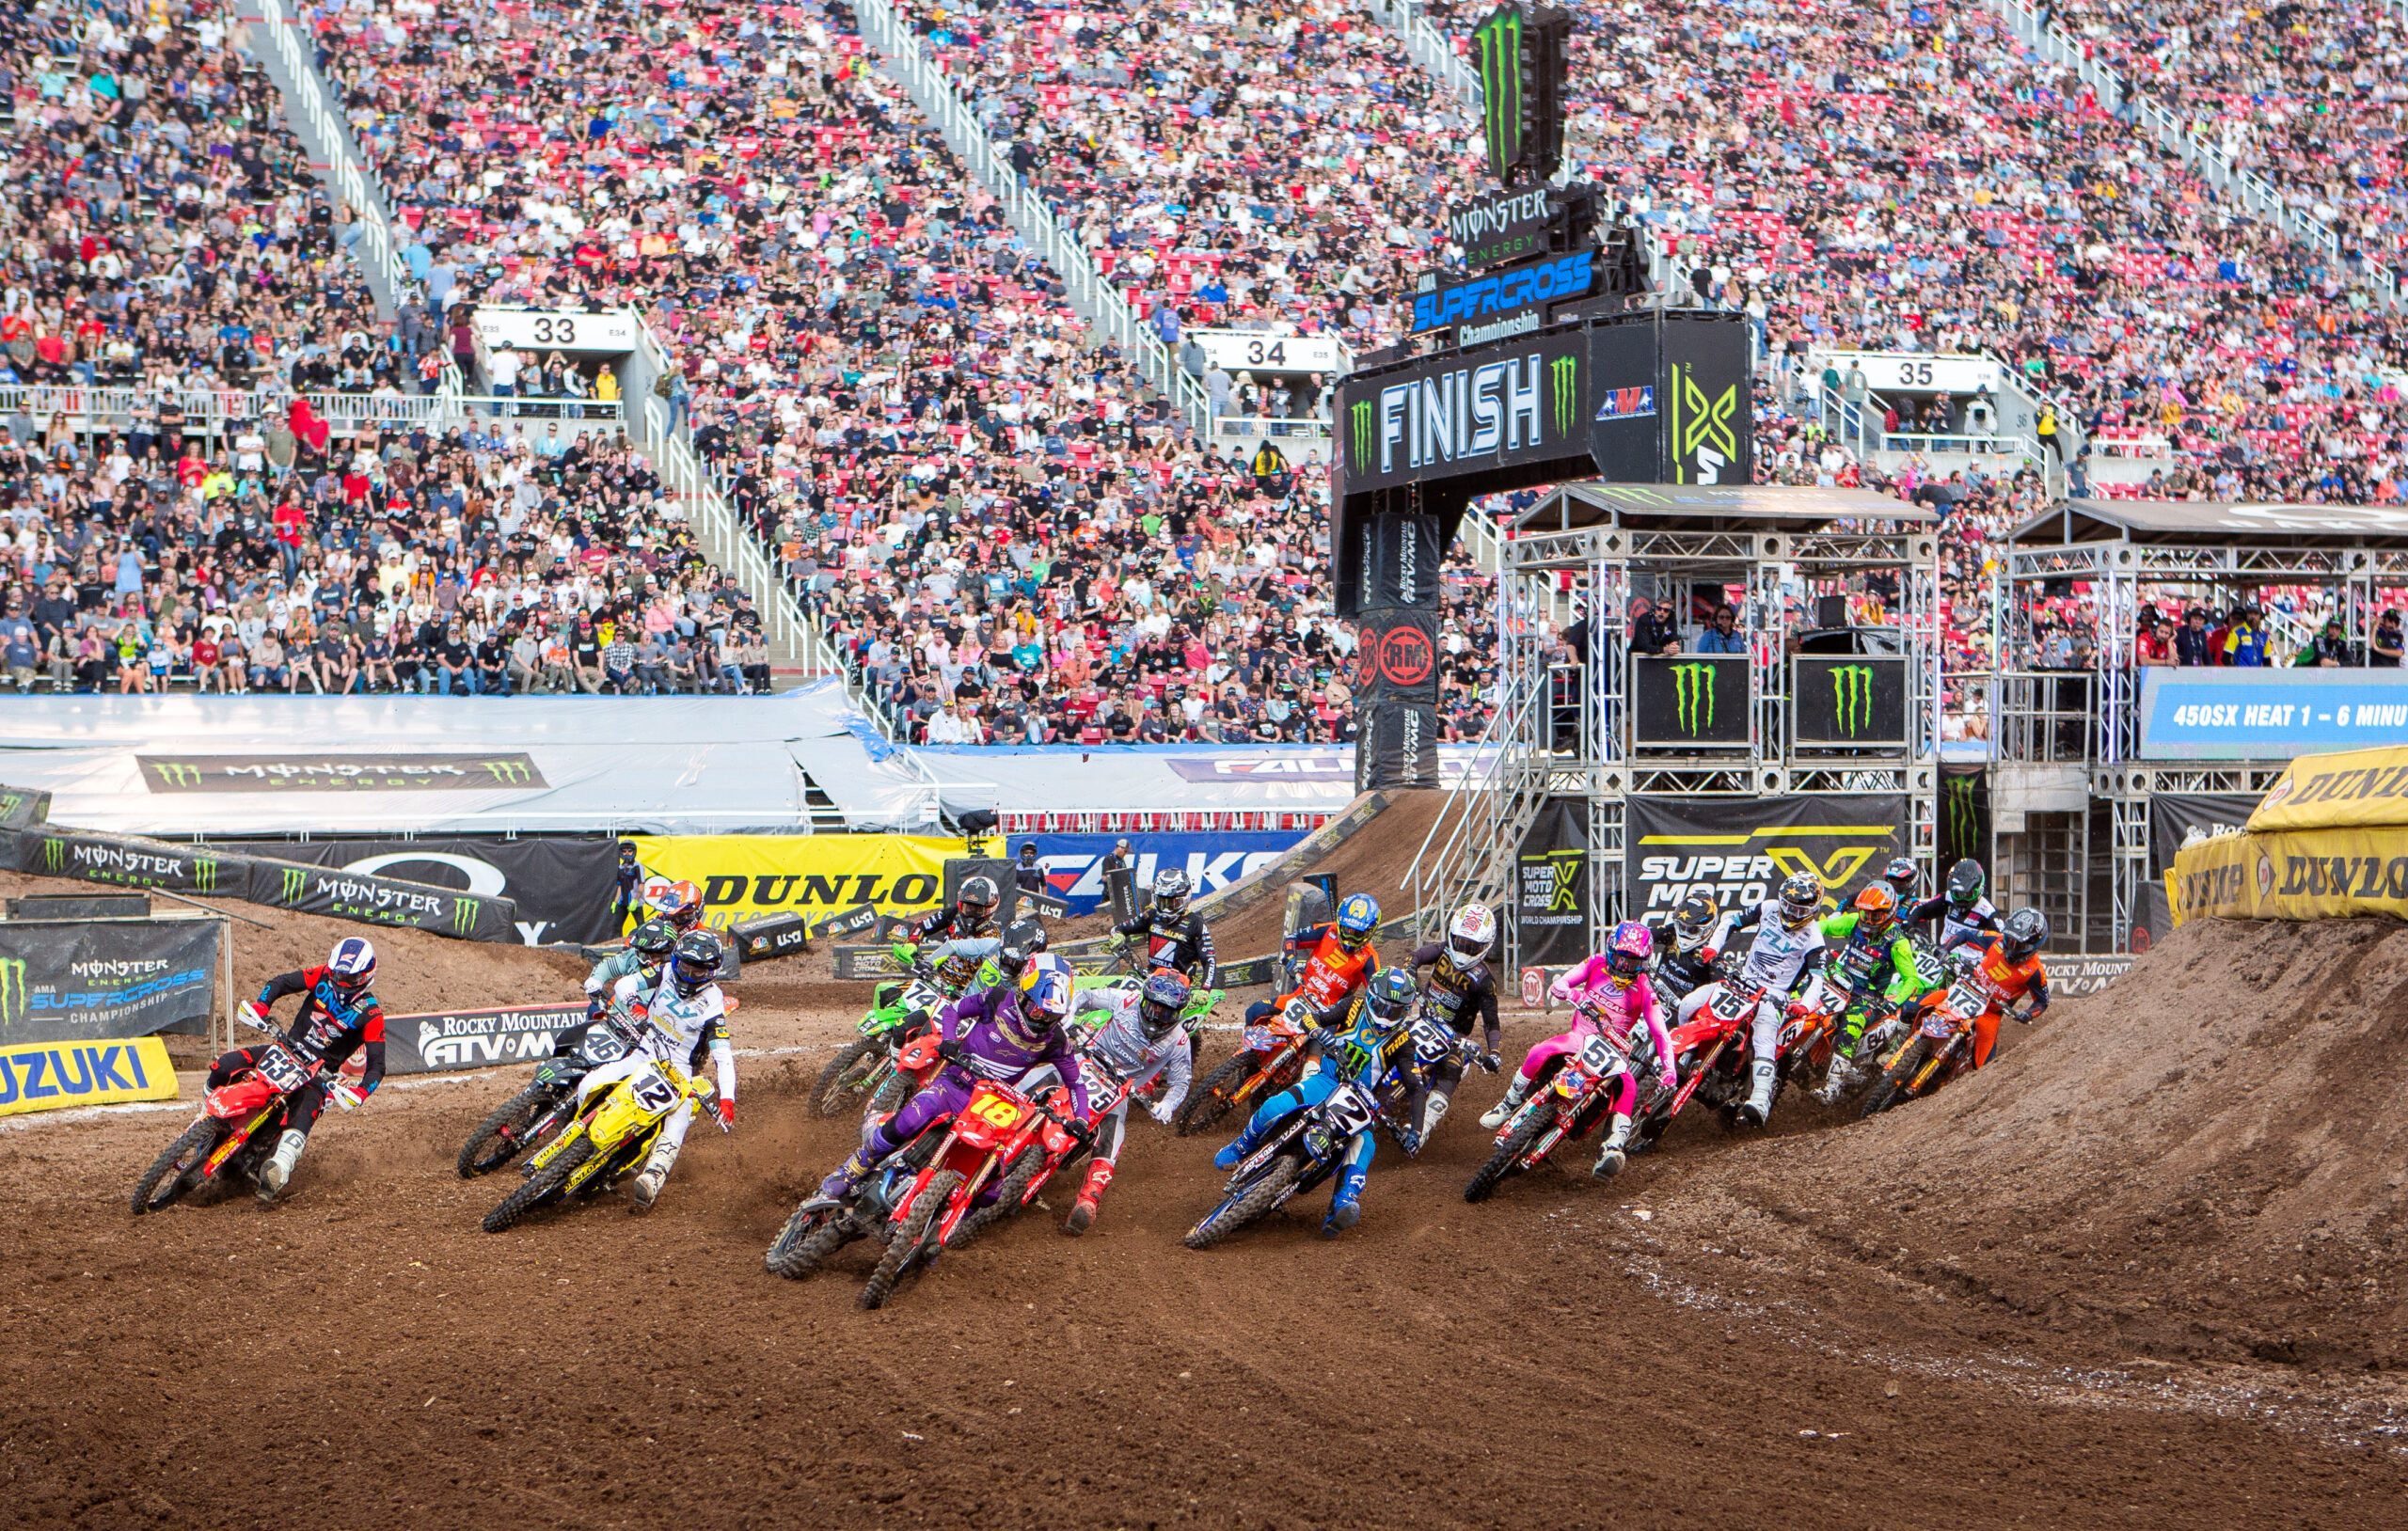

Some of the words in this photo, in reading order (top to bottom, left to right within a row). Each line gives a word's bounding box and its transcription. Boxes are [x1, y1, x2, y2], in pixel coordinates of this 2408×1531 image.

[1451, 189, 1549, 243] MONSTER
[1467, 234, 1534, 264] ENERGY
[1413, 250, 1593, 331] SUPERCROSS
[1418, 272, 1437, 294] AMA
[533, 317, 576, 344] 33
[1459, 309, 1540, 347] Championship
[1247, 340, 1286, 367] 34
[1898, 362, 1933, 386] 35
[1380, 353, 1542, 474] FINISH
[1595, 385, 1656, 418] AMA
[1399, 520, 1408, 562] MOUNTAIN
[2173, 704, 2237, 727] 450SX
[2243, 704, 2295, 727] HEAT
[2301, 704, 2311, 727] 1
[2337, 704, 2351, 727] 6
[1402, 708, 1411, 751] MOUNTAIN
[225, 762, 467, 779] MONSTER
[269, 777, 432, 786] ENERGY
[73, 844, 184, 878] MONSTER
[1522, 865, 1555, 879] SUPER
[1638, 855, 1775, 880] SUPER
[89, 869, 166, 887] ENERGY
[704, 874, 943, 906] DUNLO
[1524, 880, 1553, 893] MOTO
[316, 876, 442, 917] MONSTER
[1522, 894, 1553, 908] CROSS
[1647, 882, 1768, 908] MOTO
[333, 903, 421, 924] ENERGY
[1520, 915, 1540, 924] WORLD
[71, 958, 169, 978] MONSTER
[87, 971, 158, 986] ENERGY
[1916, 954, 1944, 982] 792
[2081, 960, 2131, 976] MOUNT
[29, 969, 206, 1010] SUPERCROSS
[34, 985, 57, 994] AMA
[1588, 989, 1627, 1016] GASGAS
[1947, 987, 1983, 1017] 173
[70, 992, 168, 1024] CHAMPIONSHIP
[1711, 991, 1746, 1018] 15
[443, 1017, 498, 1036] ROCKY
[501, 1012, 588, 1033] MOUNTAIN
[584, 1032, 624, 1061] 46
[1384, 1031, 1410, 1057] THOR
[1411, 1024, 1450, 1060] 23
[1582, 1038, 1621, 1079] 51
[638, 1073, 673, 1111] 12
[970, 1093, 1022, 1128] 18
